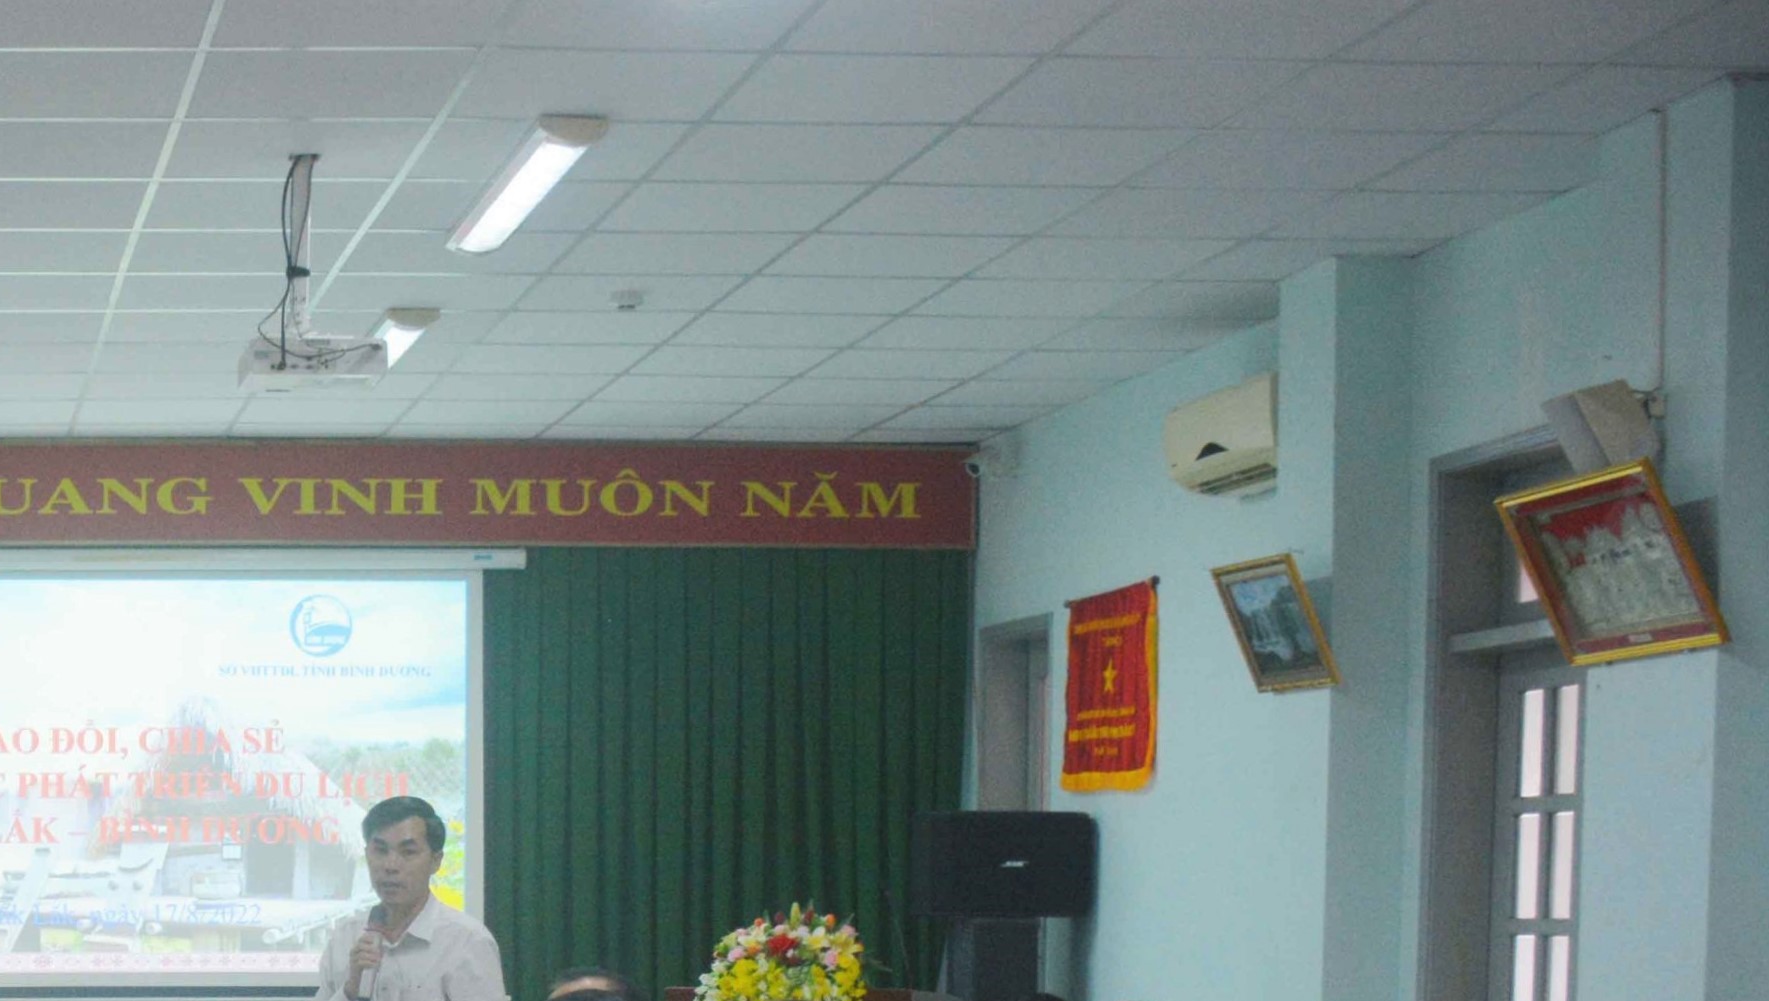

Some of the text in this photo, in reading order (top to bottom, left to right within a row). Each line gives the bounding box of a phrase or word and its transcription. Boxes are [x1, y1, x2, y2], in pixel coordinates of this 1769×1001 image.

[238, 478, 444, 516] VINH
[468, 468, 715, 518] MUÔN
[739, 470, 922, 519] NĂM
[138, 726, 234, 756] CHIA
[242, 719, 284, 755] SẺ
[17, 764, 119, 799] PHÁT
[254, 771, 305, 799] DU
[316, 771, 410, 806] LỊCH
[100, 809, 191, 845] BÌNH
[202, 812, 340, 845] DƯƠNG
[153, 903, 263, 925] 17/8/2022
